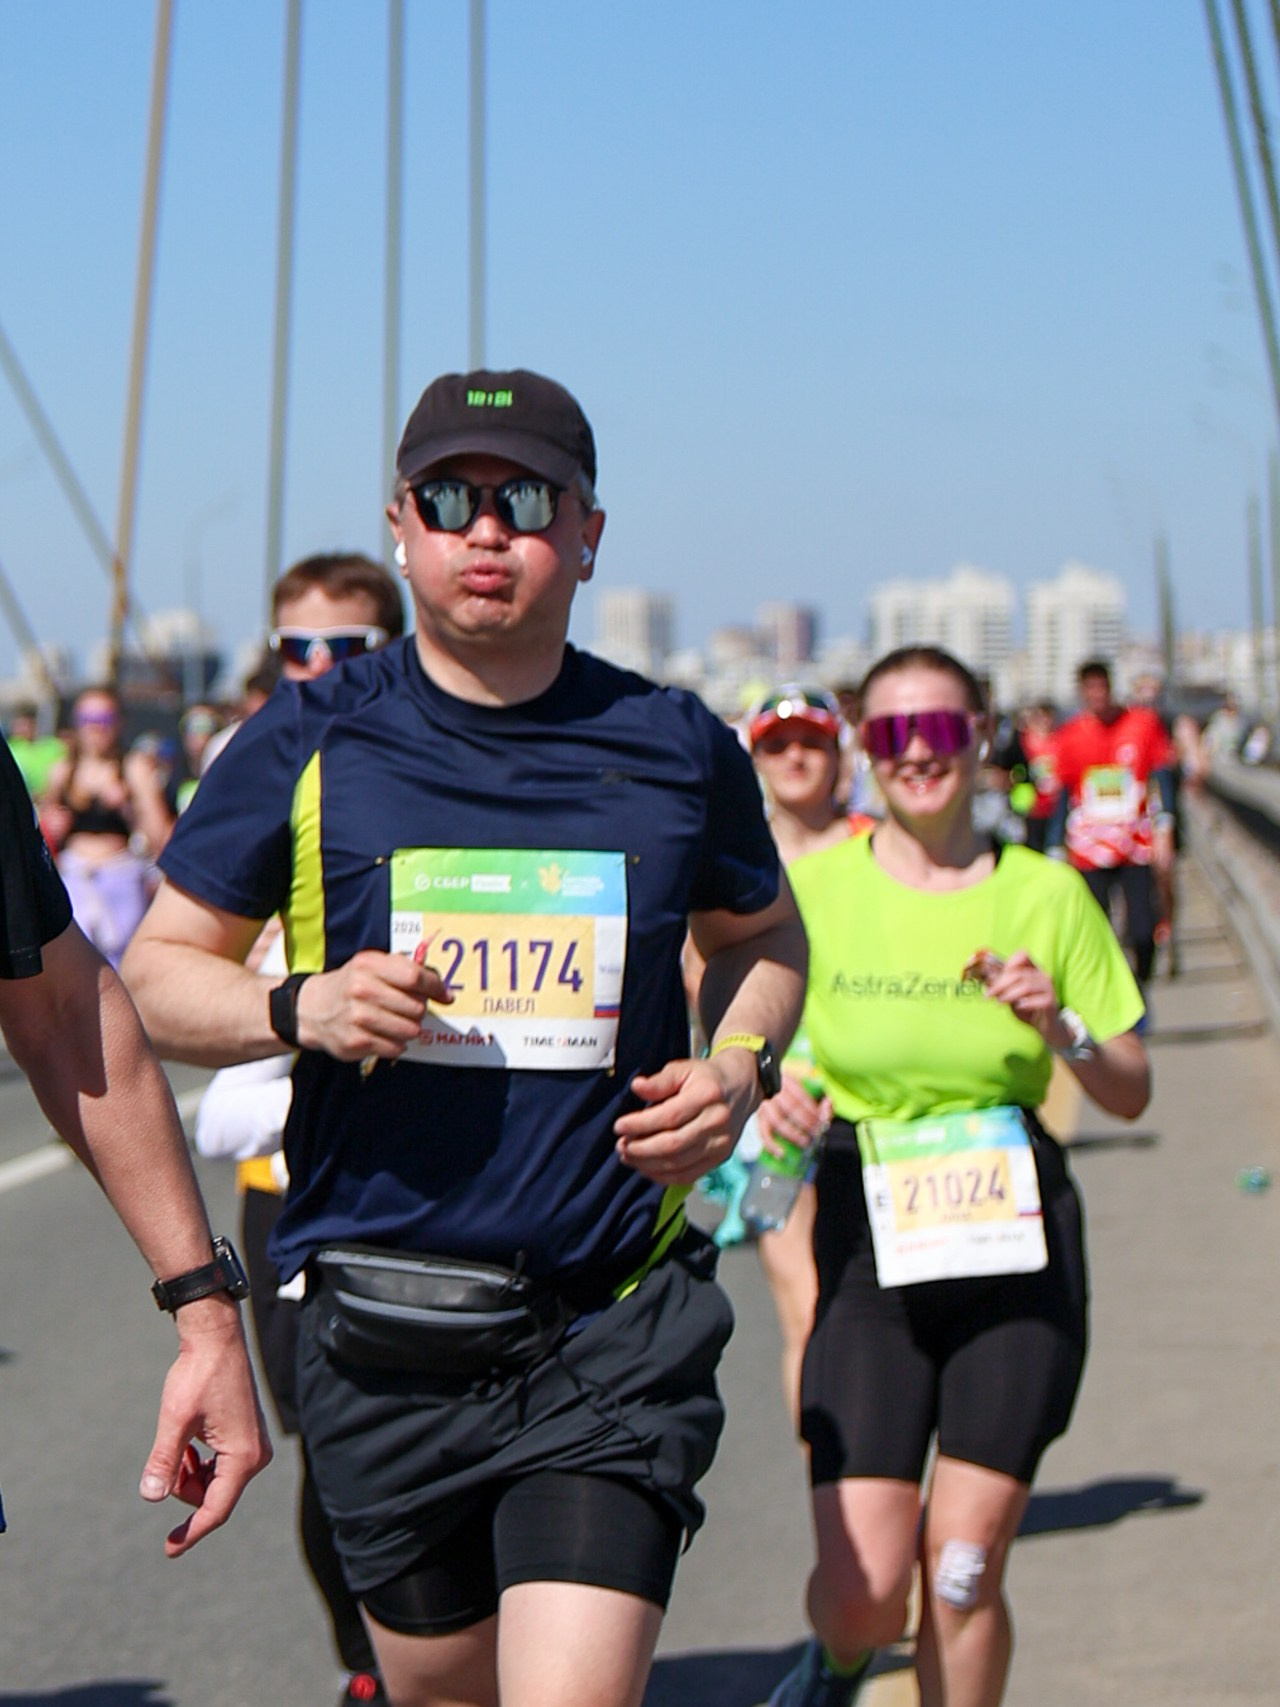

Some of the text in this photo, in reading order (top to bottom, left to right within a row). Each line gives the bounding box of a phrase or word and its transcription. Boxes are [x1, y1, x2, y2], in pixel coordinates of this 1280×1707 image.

[394, 920, 421, 934] 2026
[441, 938, 584, 993] 21174
[832, 970, 986, 998] AstraZene
[483, 997, 535, 1014] ПАВЕЛ
[904, 1162, 1006, 1215] 21024
